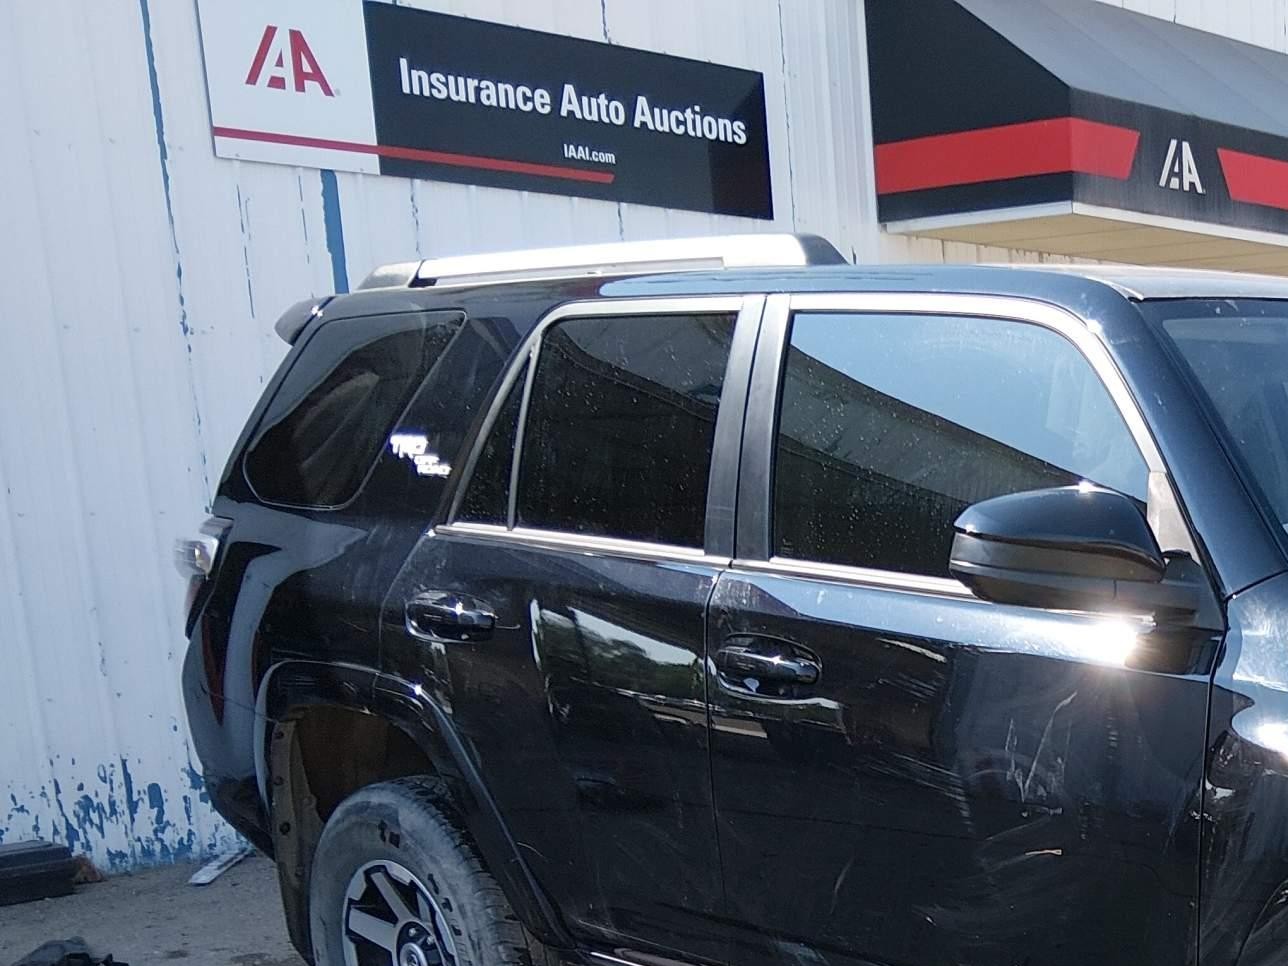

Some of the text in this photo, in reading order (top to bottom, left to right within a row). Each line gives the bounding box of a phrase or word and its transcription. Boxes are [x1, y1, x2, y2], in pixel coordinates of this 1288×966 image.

[399, 57, 747, 145] Insurance Auto Auctions
[563, 143, 616, 165] IAAI.com
